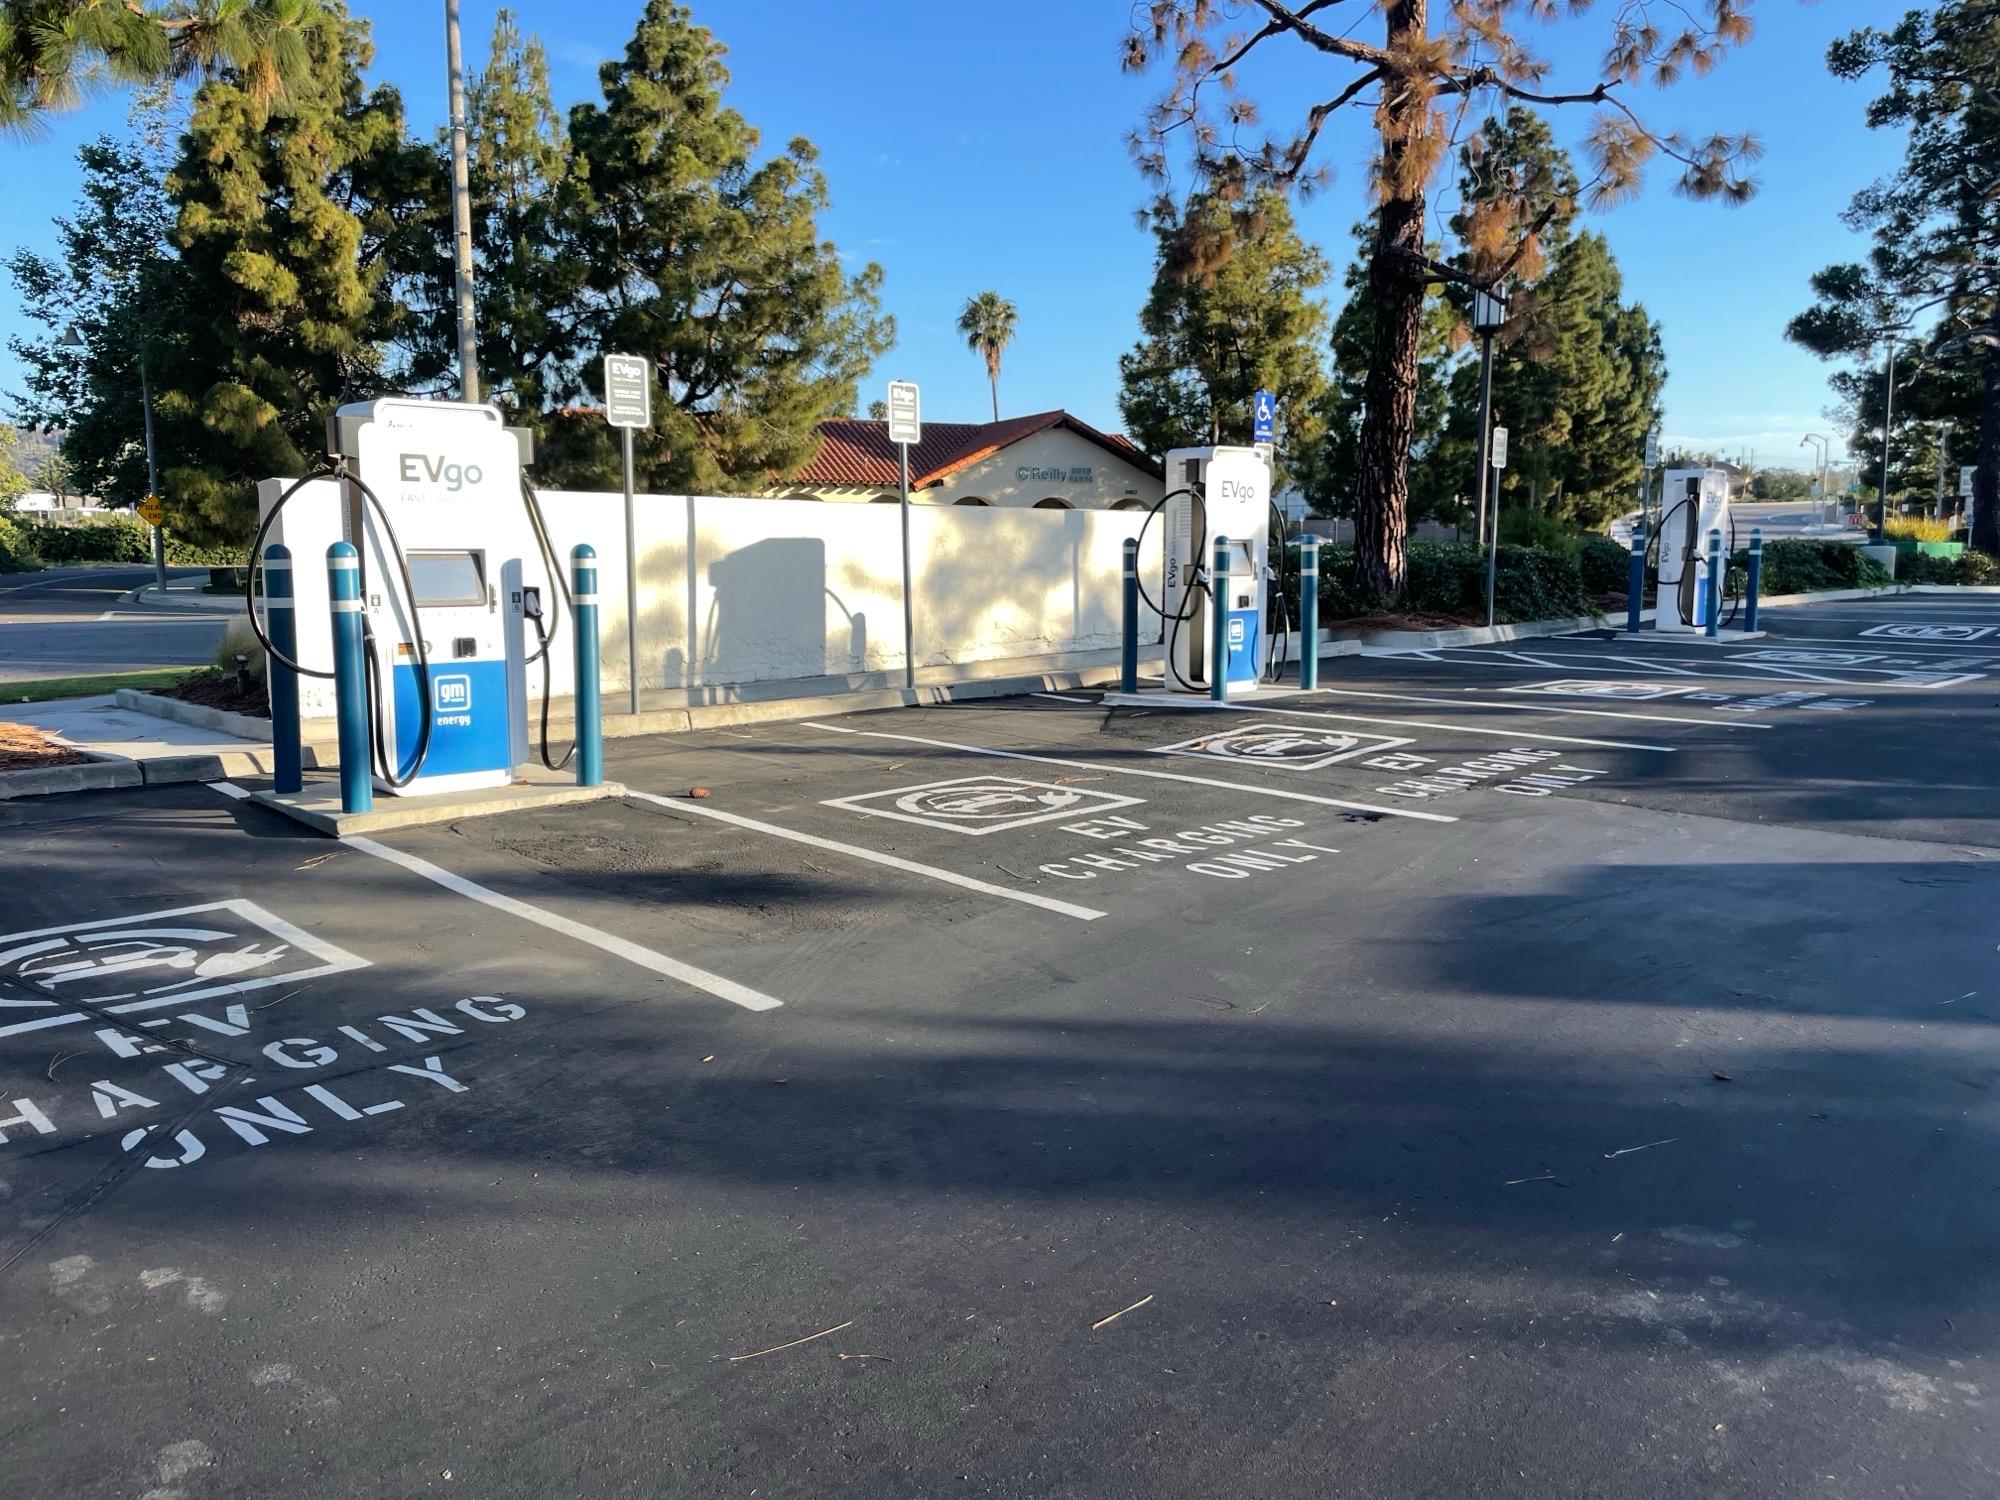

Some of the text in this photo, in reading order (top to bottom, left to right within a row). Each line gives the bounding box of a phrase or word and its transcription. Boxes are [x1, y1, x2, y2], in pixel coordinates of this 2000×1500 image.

[612, 362, 641, 378] EVgo
[399, 453, 483, 492] EVgo
[1222, 480, 1254, 503] EVgo
[1168, 558, 1178, 588] EVgo
[441, 683, 465, 702] gm
[437, 714, 471, 726] energy
[1360, 752, 1437, 770] EV
[1375, 747, 1562, 798] CHARGING
[1494, 764, 1608, 797] ONLY
[1057, 815, 1150, 839] EV
[1038, 815, 1305, 879] CHARGING
[1185, 838, 1341, 879] ONLY
[94, 1003, 250, 1059] EV
[121, 1056, 470, 1169] ONLY
